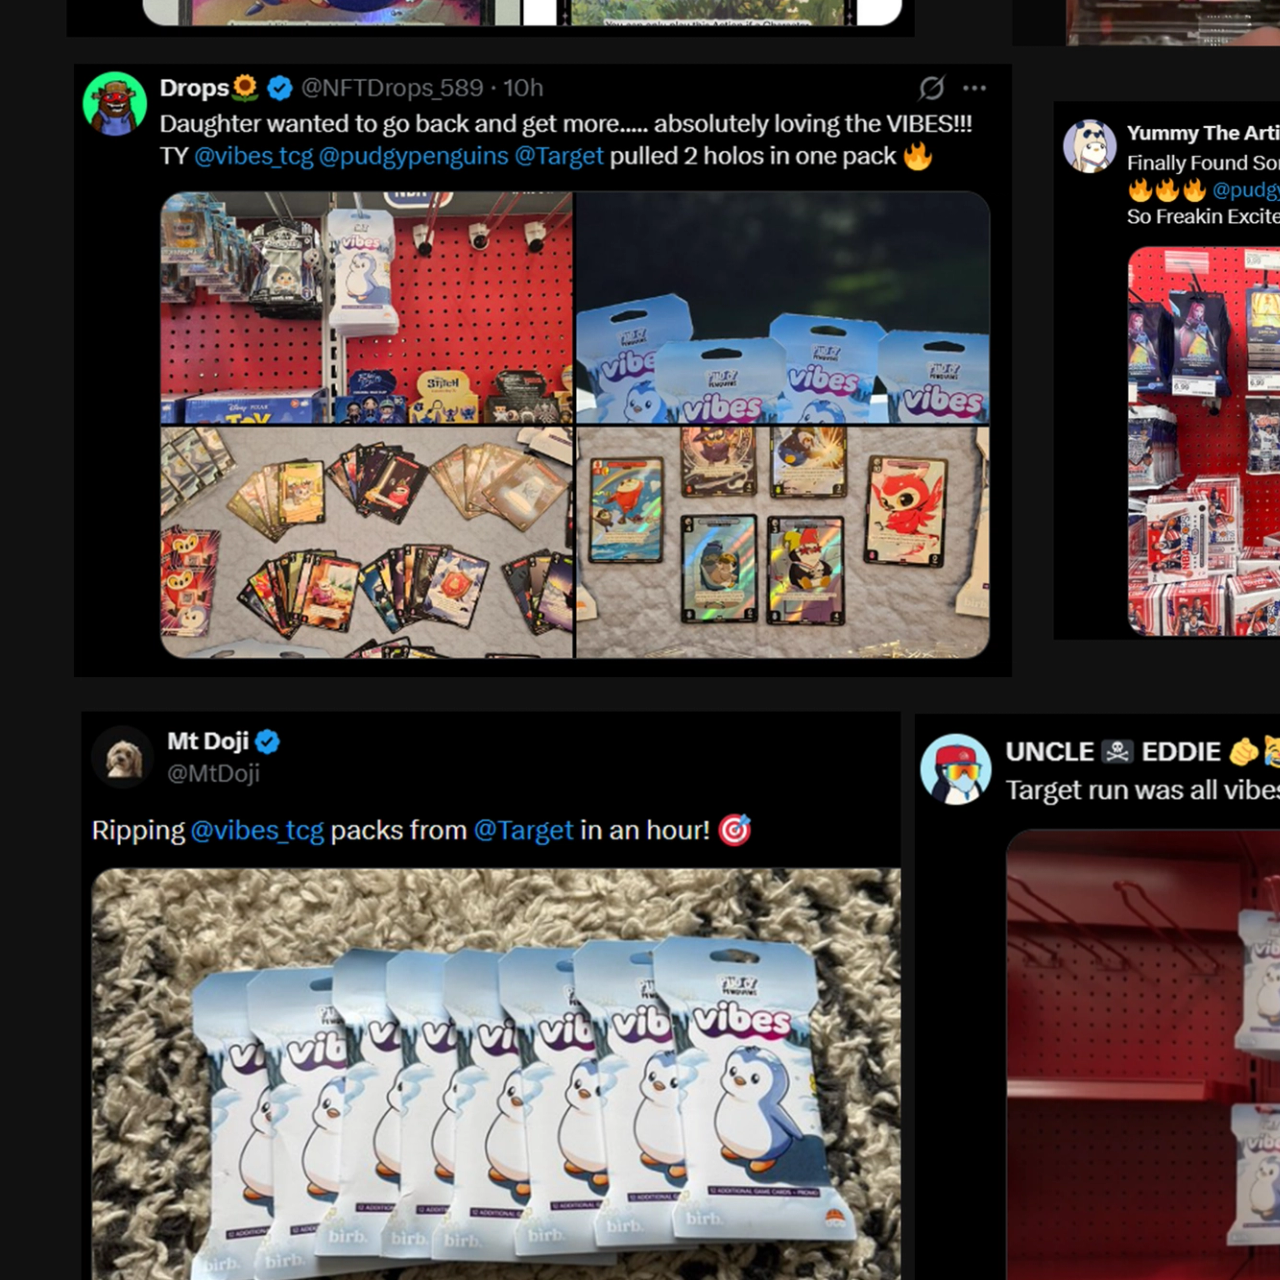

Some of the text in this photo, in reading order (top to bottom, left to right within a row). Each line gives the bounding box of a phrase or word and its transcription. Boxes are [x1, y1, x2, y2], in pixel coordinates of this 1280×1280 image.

[161, 79, 229, 101] Drops
[1127, 126, 1197, 144] Yummy
[1203, 125, 1238, 140] The
[168, 731, 248, 754] Mt Doji
[1007, 742, 1221, 761] UNCLE EDDIE
[693, 1000, 791, 1040] vibes
